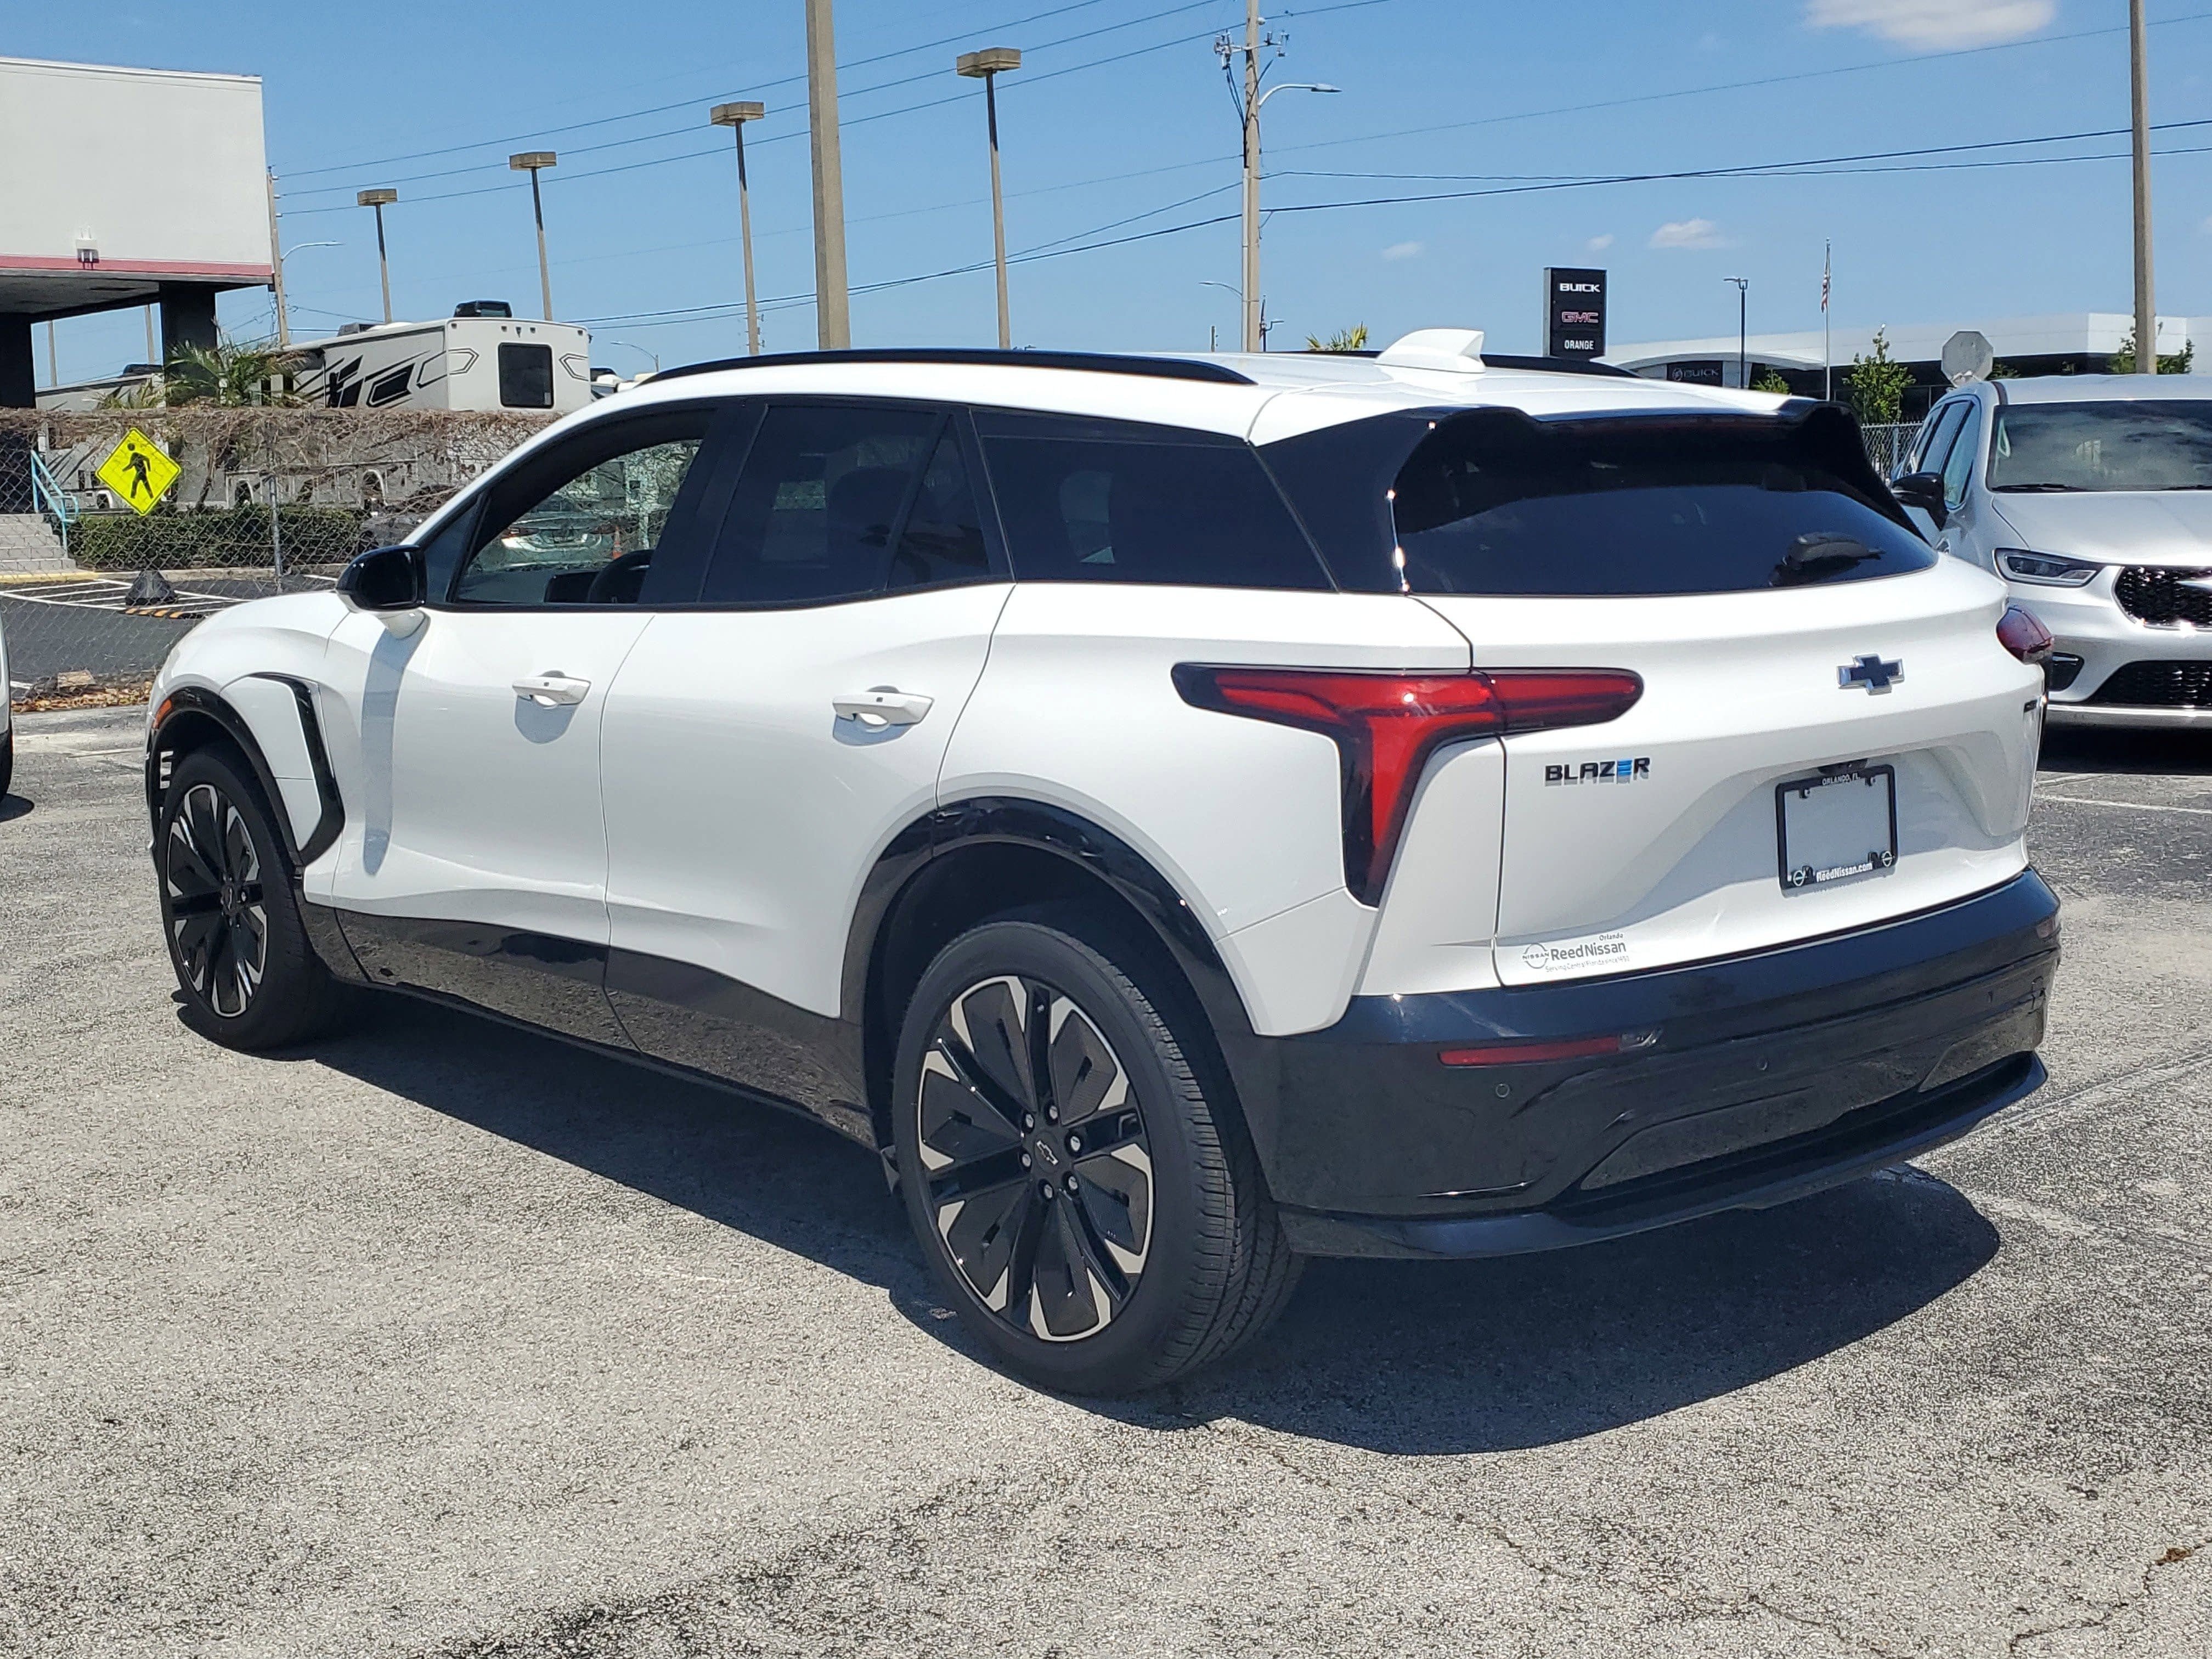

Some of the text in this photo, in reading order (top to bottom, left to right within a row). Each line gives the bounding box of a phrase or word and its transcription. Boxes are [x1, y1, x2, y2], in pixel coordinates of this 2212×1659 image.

[1560, 283, 1600, 292] BUICK
[1561, 312, 1599, 323] GMC
[1564, 340, 1594, 351] ORANGE
[1544, 757, 1650, 782] BLAZER
[1816, 862, 1873, 883] ReedNissan.com
[1599, 933, 1623, 941] Orlando
[1522, 952, 1549, 960] NISSAN
